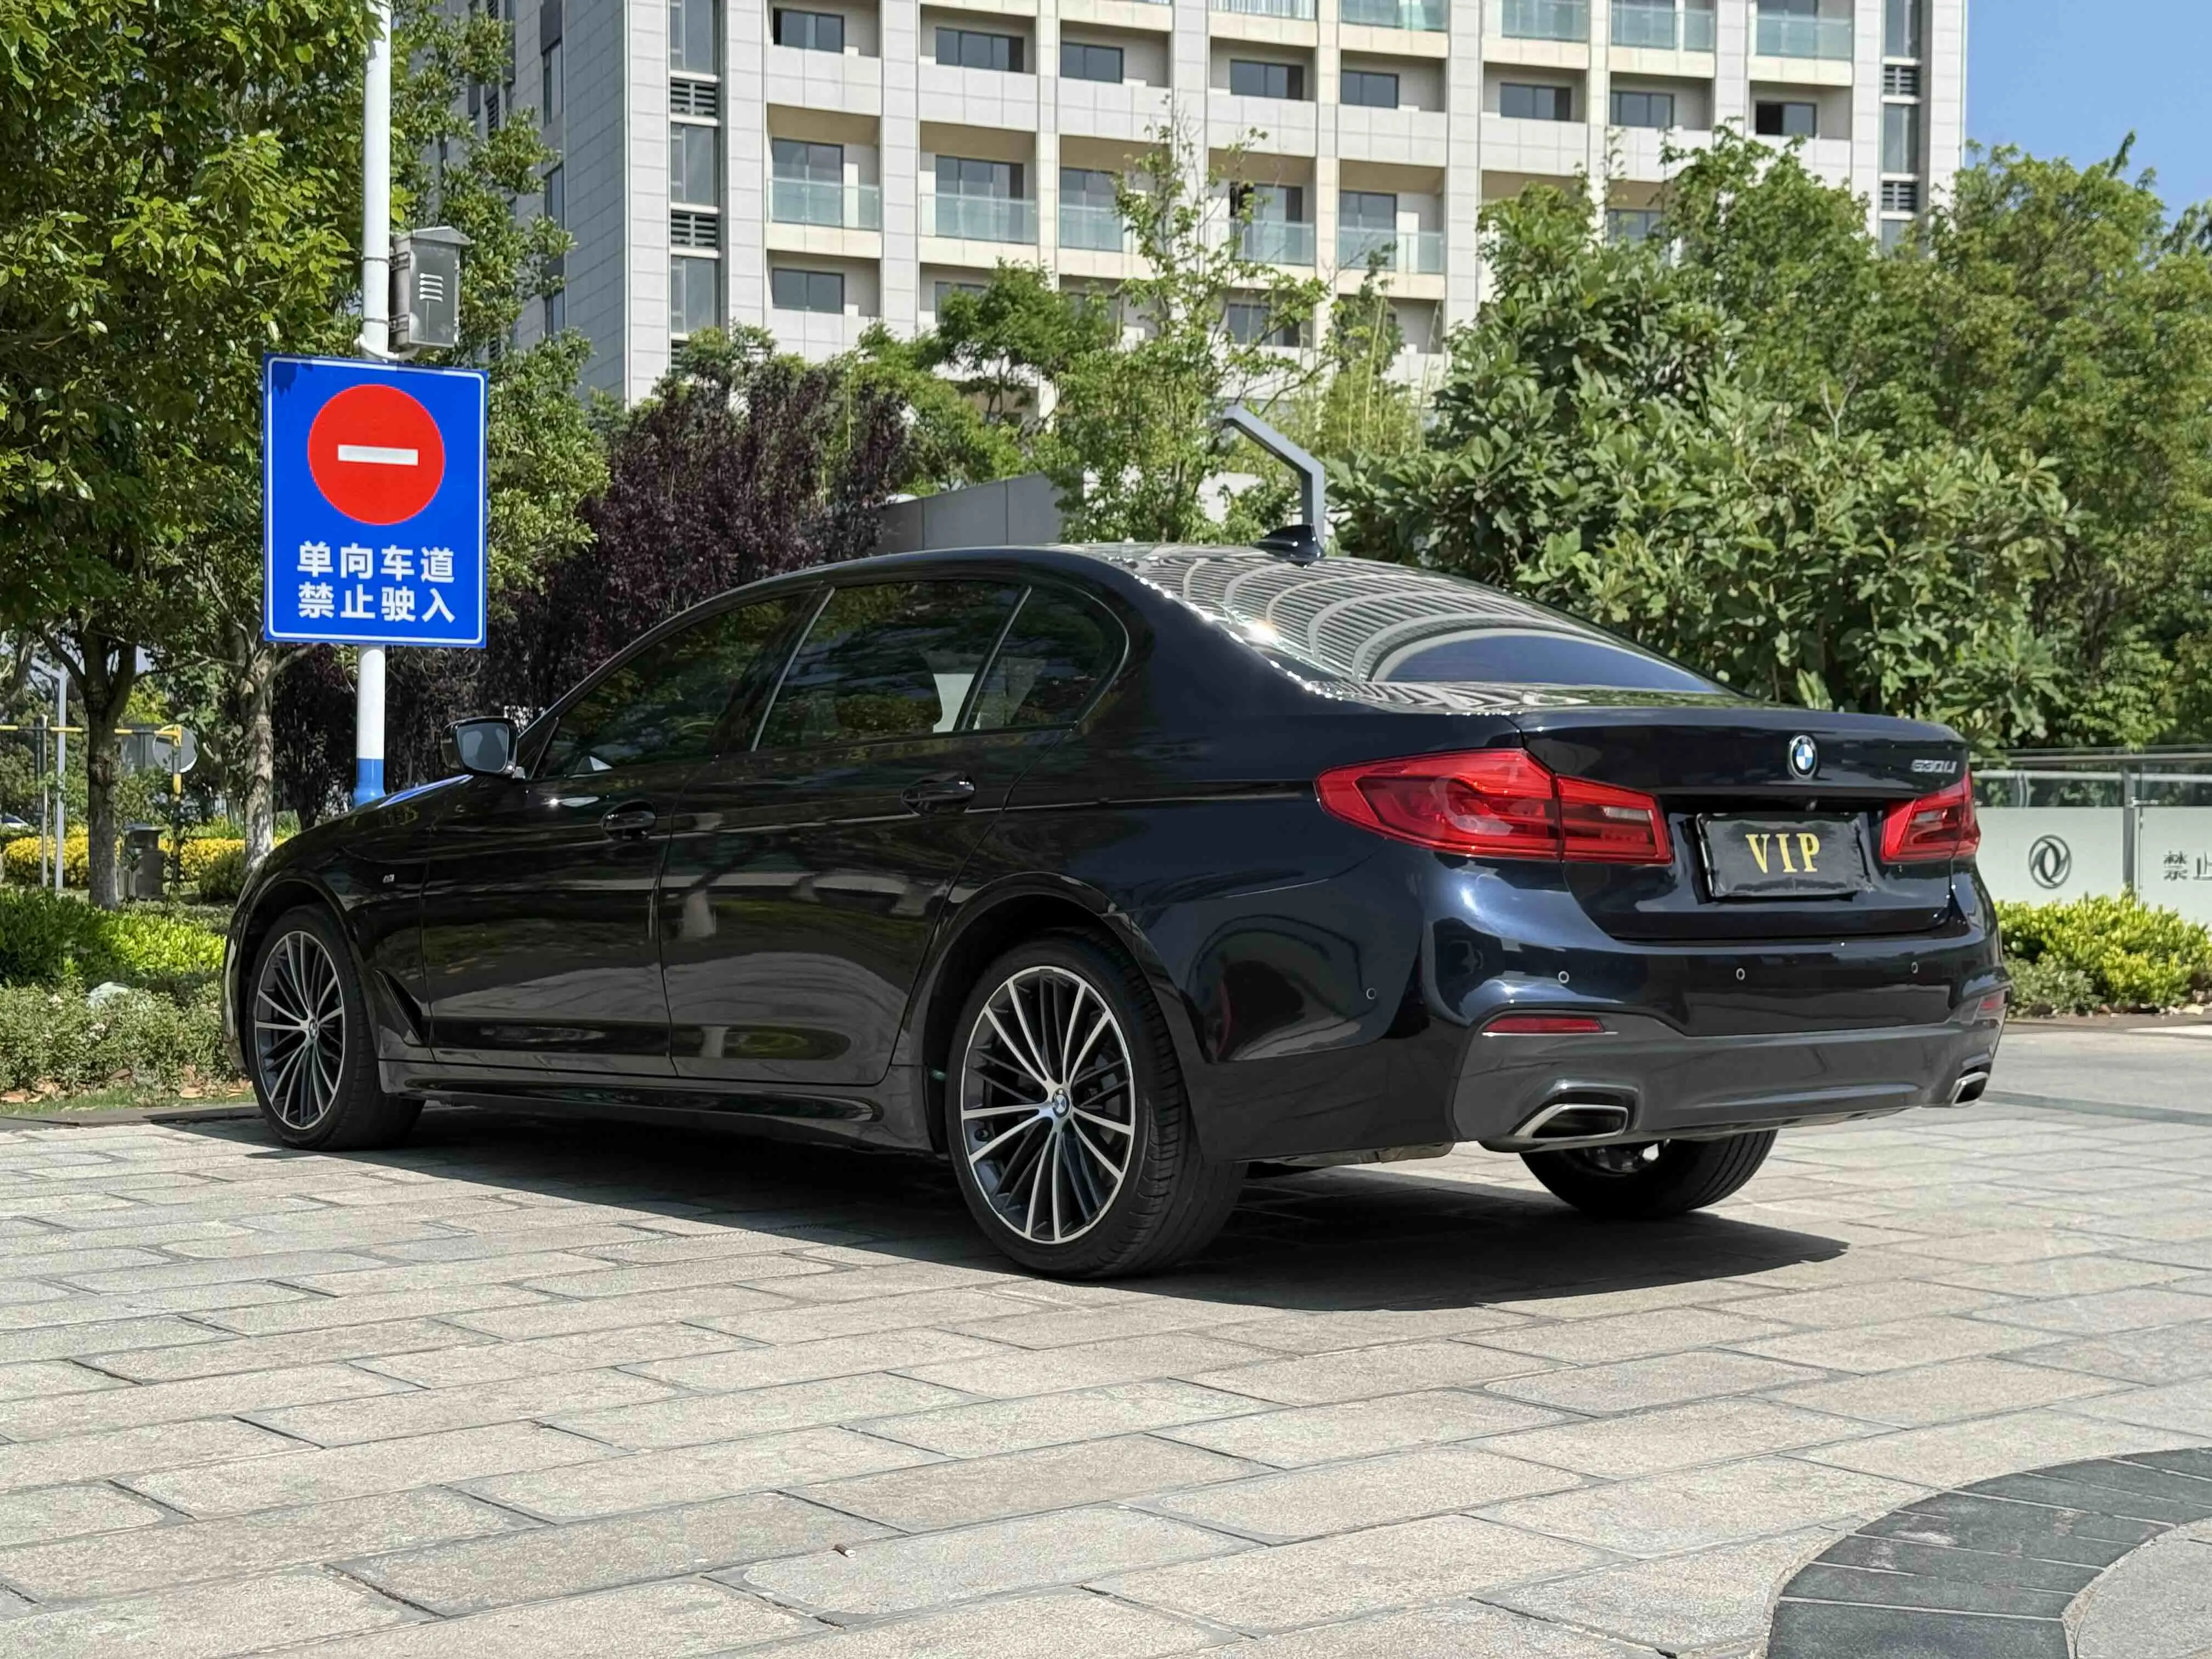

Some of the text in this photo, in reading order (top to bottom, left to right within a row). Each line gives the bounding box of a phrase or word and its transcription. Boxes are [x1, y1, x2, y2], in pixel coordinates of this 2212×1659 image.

[297, 540, 455, 583] 单向车道
[298, 582, 456, 623] 禁止驶入
[1745, 833, 1820, 873] VIP
